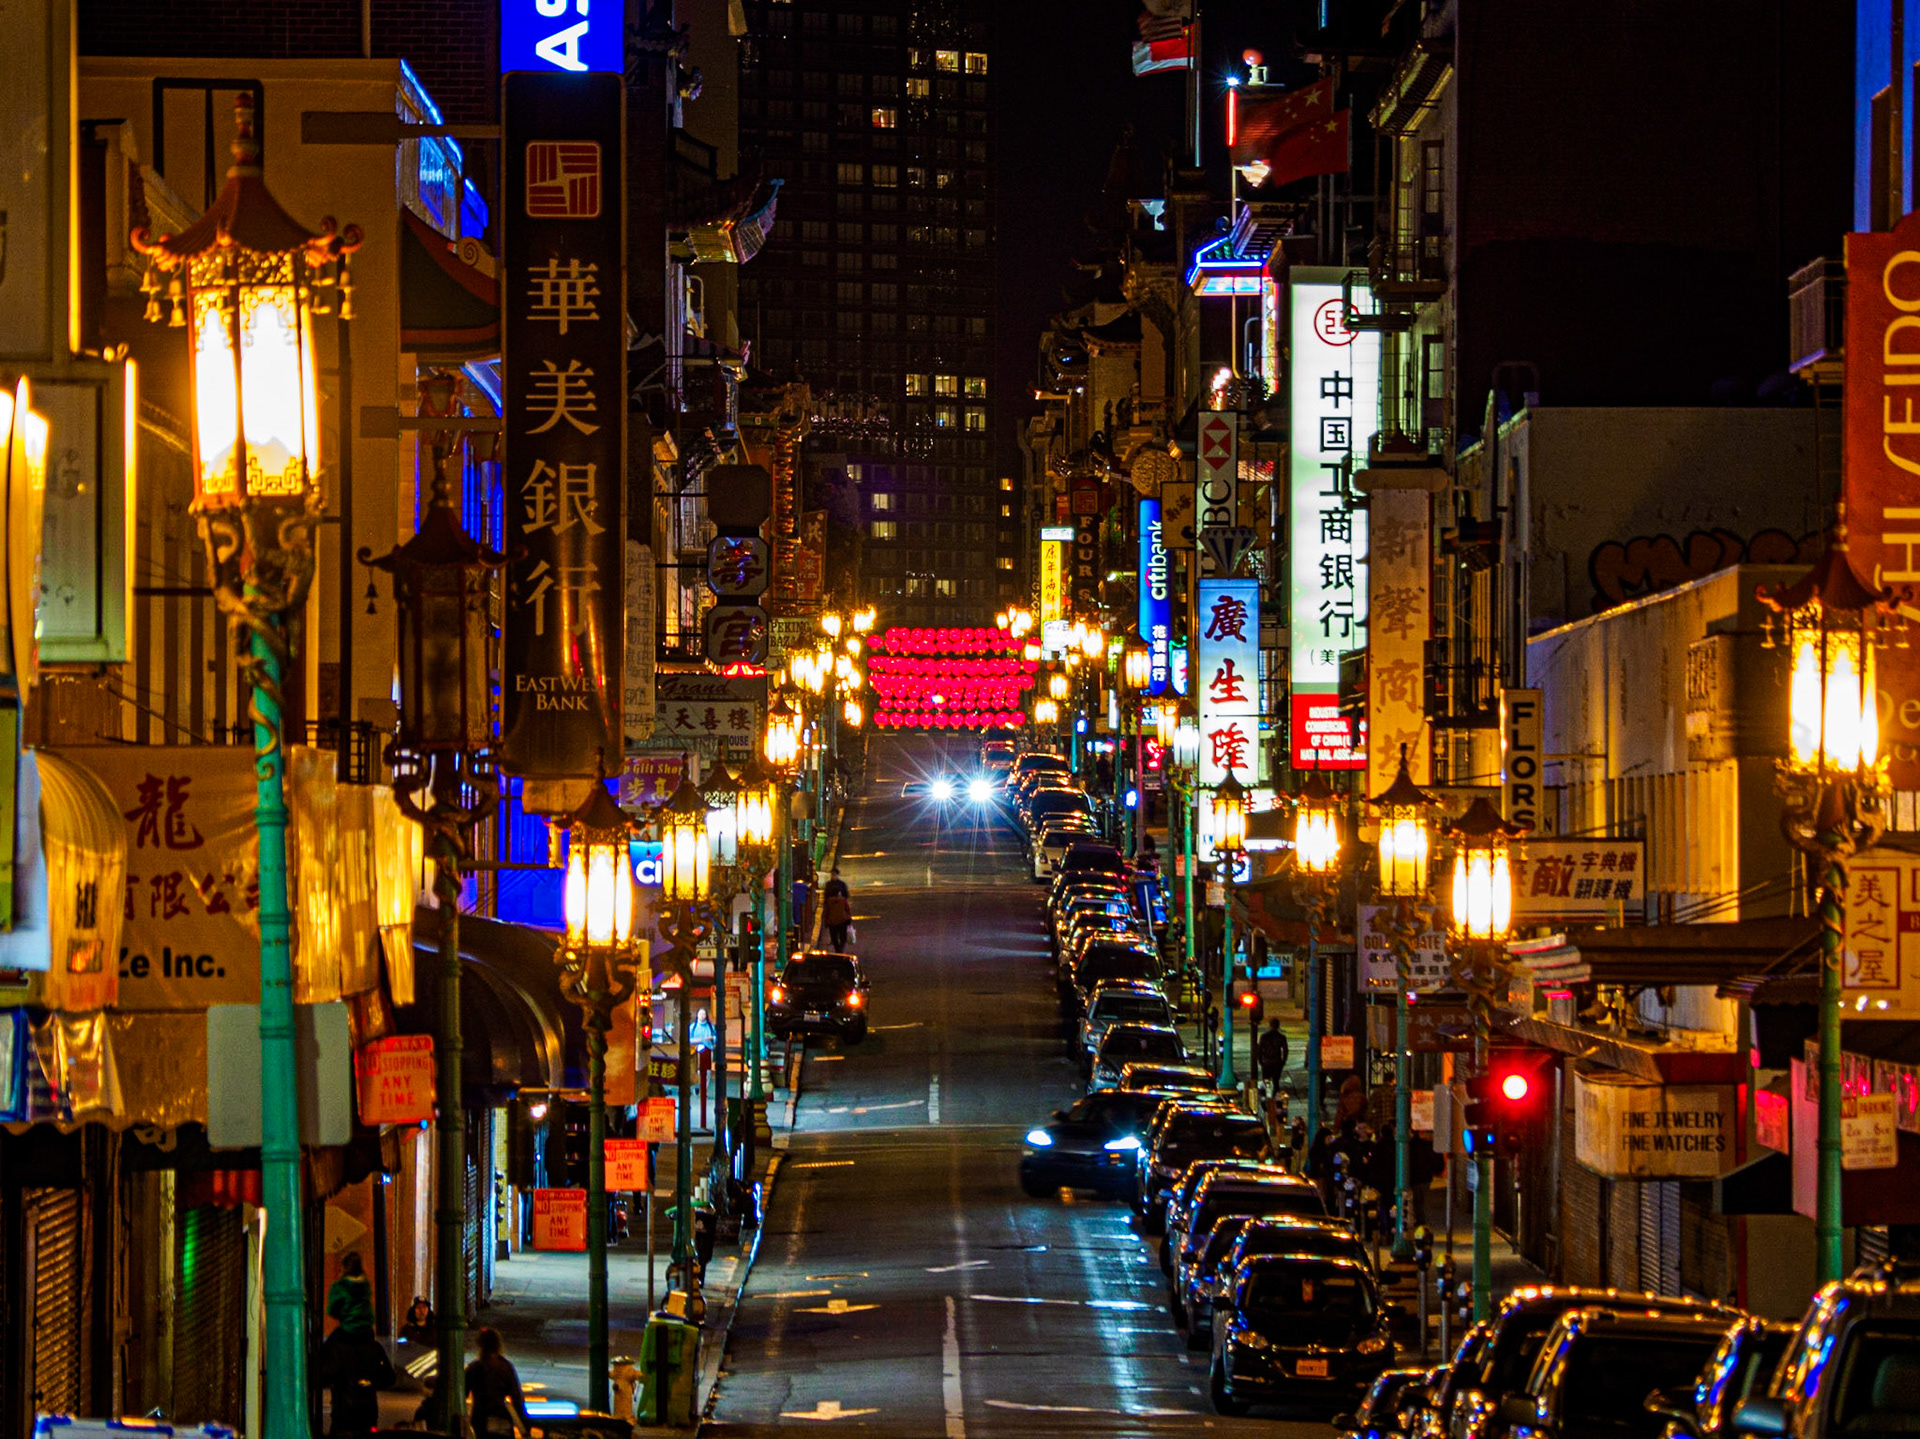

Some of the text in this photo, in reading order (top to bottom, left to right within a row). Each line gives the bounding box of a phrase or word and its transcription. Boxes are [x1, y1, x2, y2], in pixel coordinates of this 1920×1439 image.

[520, 257, 606, 637] 華美銀行
[1319, 371, 1354, 638] 中国工商银行
[1077, 515, 1094, 577] FOUR
[1146, 520, 1168, 601] citibank
[770, 621, 812, 633] PEKING
[662, 676, 731, 695] Grand
[1204, 595, 1249, 770] 廣生隆
[536, 694, 590, 711] BANK
[124, 773, 204, 850] 龍
[1849, 873, 1892, 984] 美之屋
[162, 946, 225, 978] Inc.
[382, 1075, 412, 1088] ANY
[380, 1092, 416, 1106] TIME
[649, 1116, 664, 1124] ANY
[1621, 1111, 1725, 1129] FINE JEWELRY
[648, 1126, 664, 1134] TIME
[1621, 1134, 1726, 1152] FINE WATCHES
[616, 1151, 644, 1160] STOPPING
[616, 1163, 633, 1171] ANY
[615, 1173, 635, 1181] TIME
[550, 1203, 583, 1213] STOPPING
[550, 1216, 569, 1225] ANY
[548, 1227, 570, 1238] TIME
